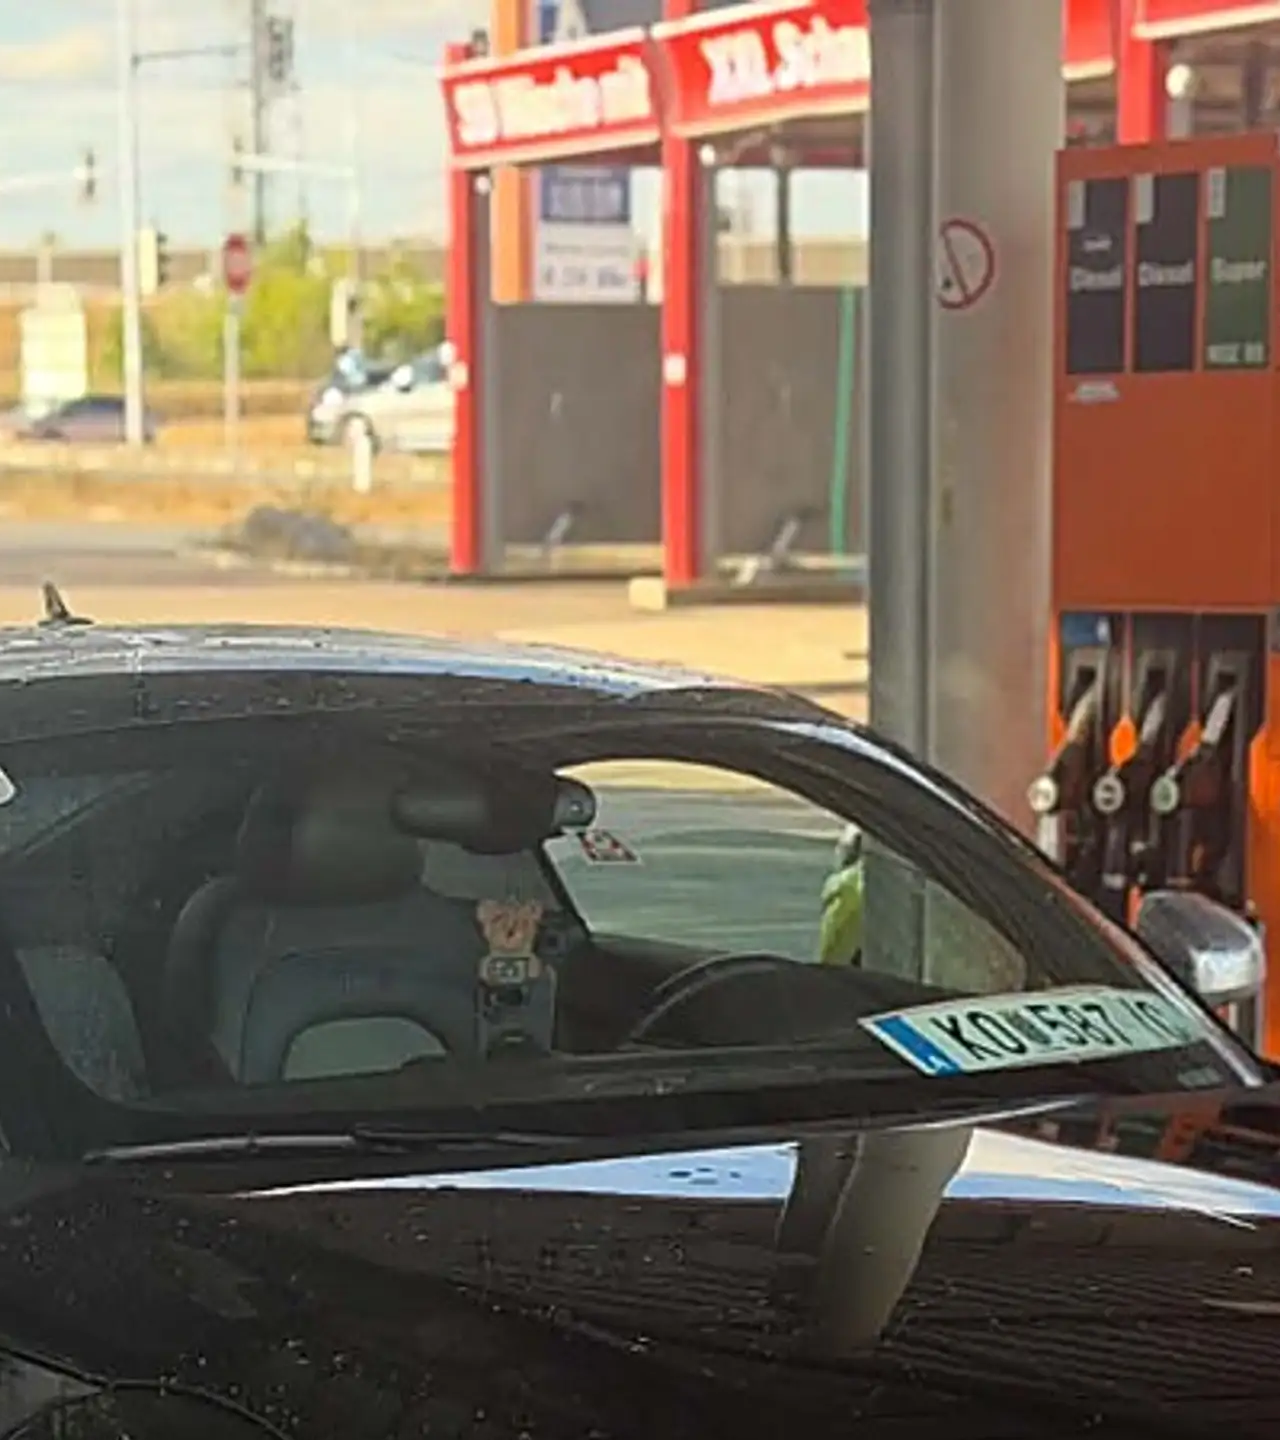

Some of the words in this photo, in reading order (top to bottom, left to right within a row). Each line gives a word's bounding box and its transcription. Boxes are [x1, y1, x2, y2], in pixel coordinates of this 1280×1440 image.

[1070, 263, 1123, 291] Diesel
[1140, 259, 1194, 287] Diesel
[1211, 257, 1267, 284] Super
[930, 1010, 1027, 1061] KO
